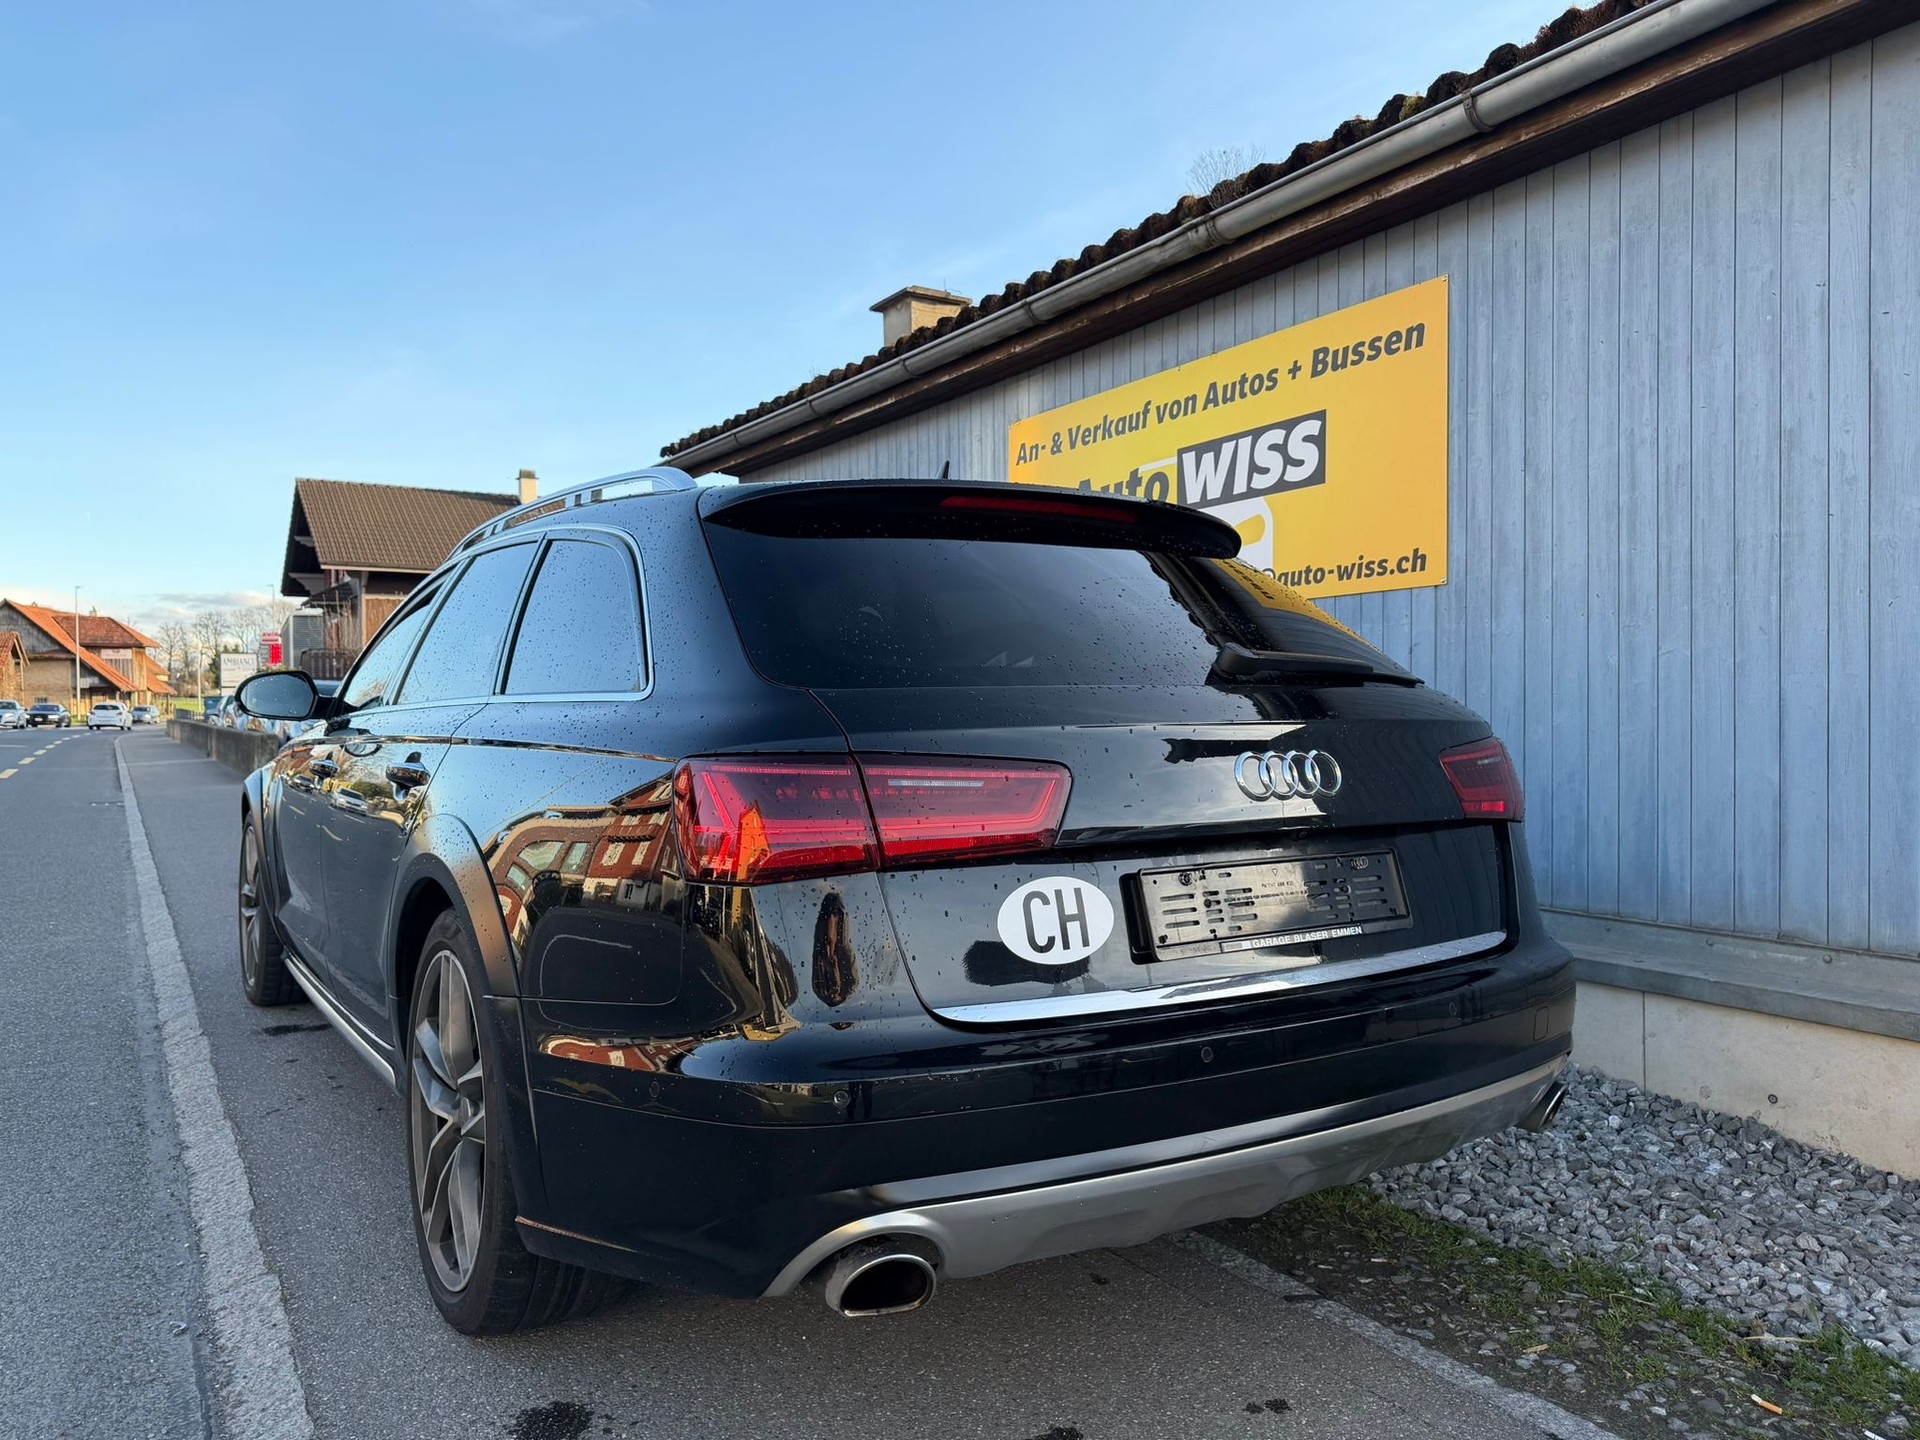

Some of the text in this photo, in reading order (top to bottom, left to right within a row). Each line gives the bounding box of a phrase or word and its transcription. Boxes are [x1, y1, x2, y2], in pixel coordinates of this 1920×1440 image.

[1016, 322, 1426, 466] An- & Verkauf von Autos + Bussen
[1182, 419, 1322, 503] WISS
[1022, 887, 1090, 954] CH
[1252, 926, 1363, 948] GARAGE BLASER EMMEN
